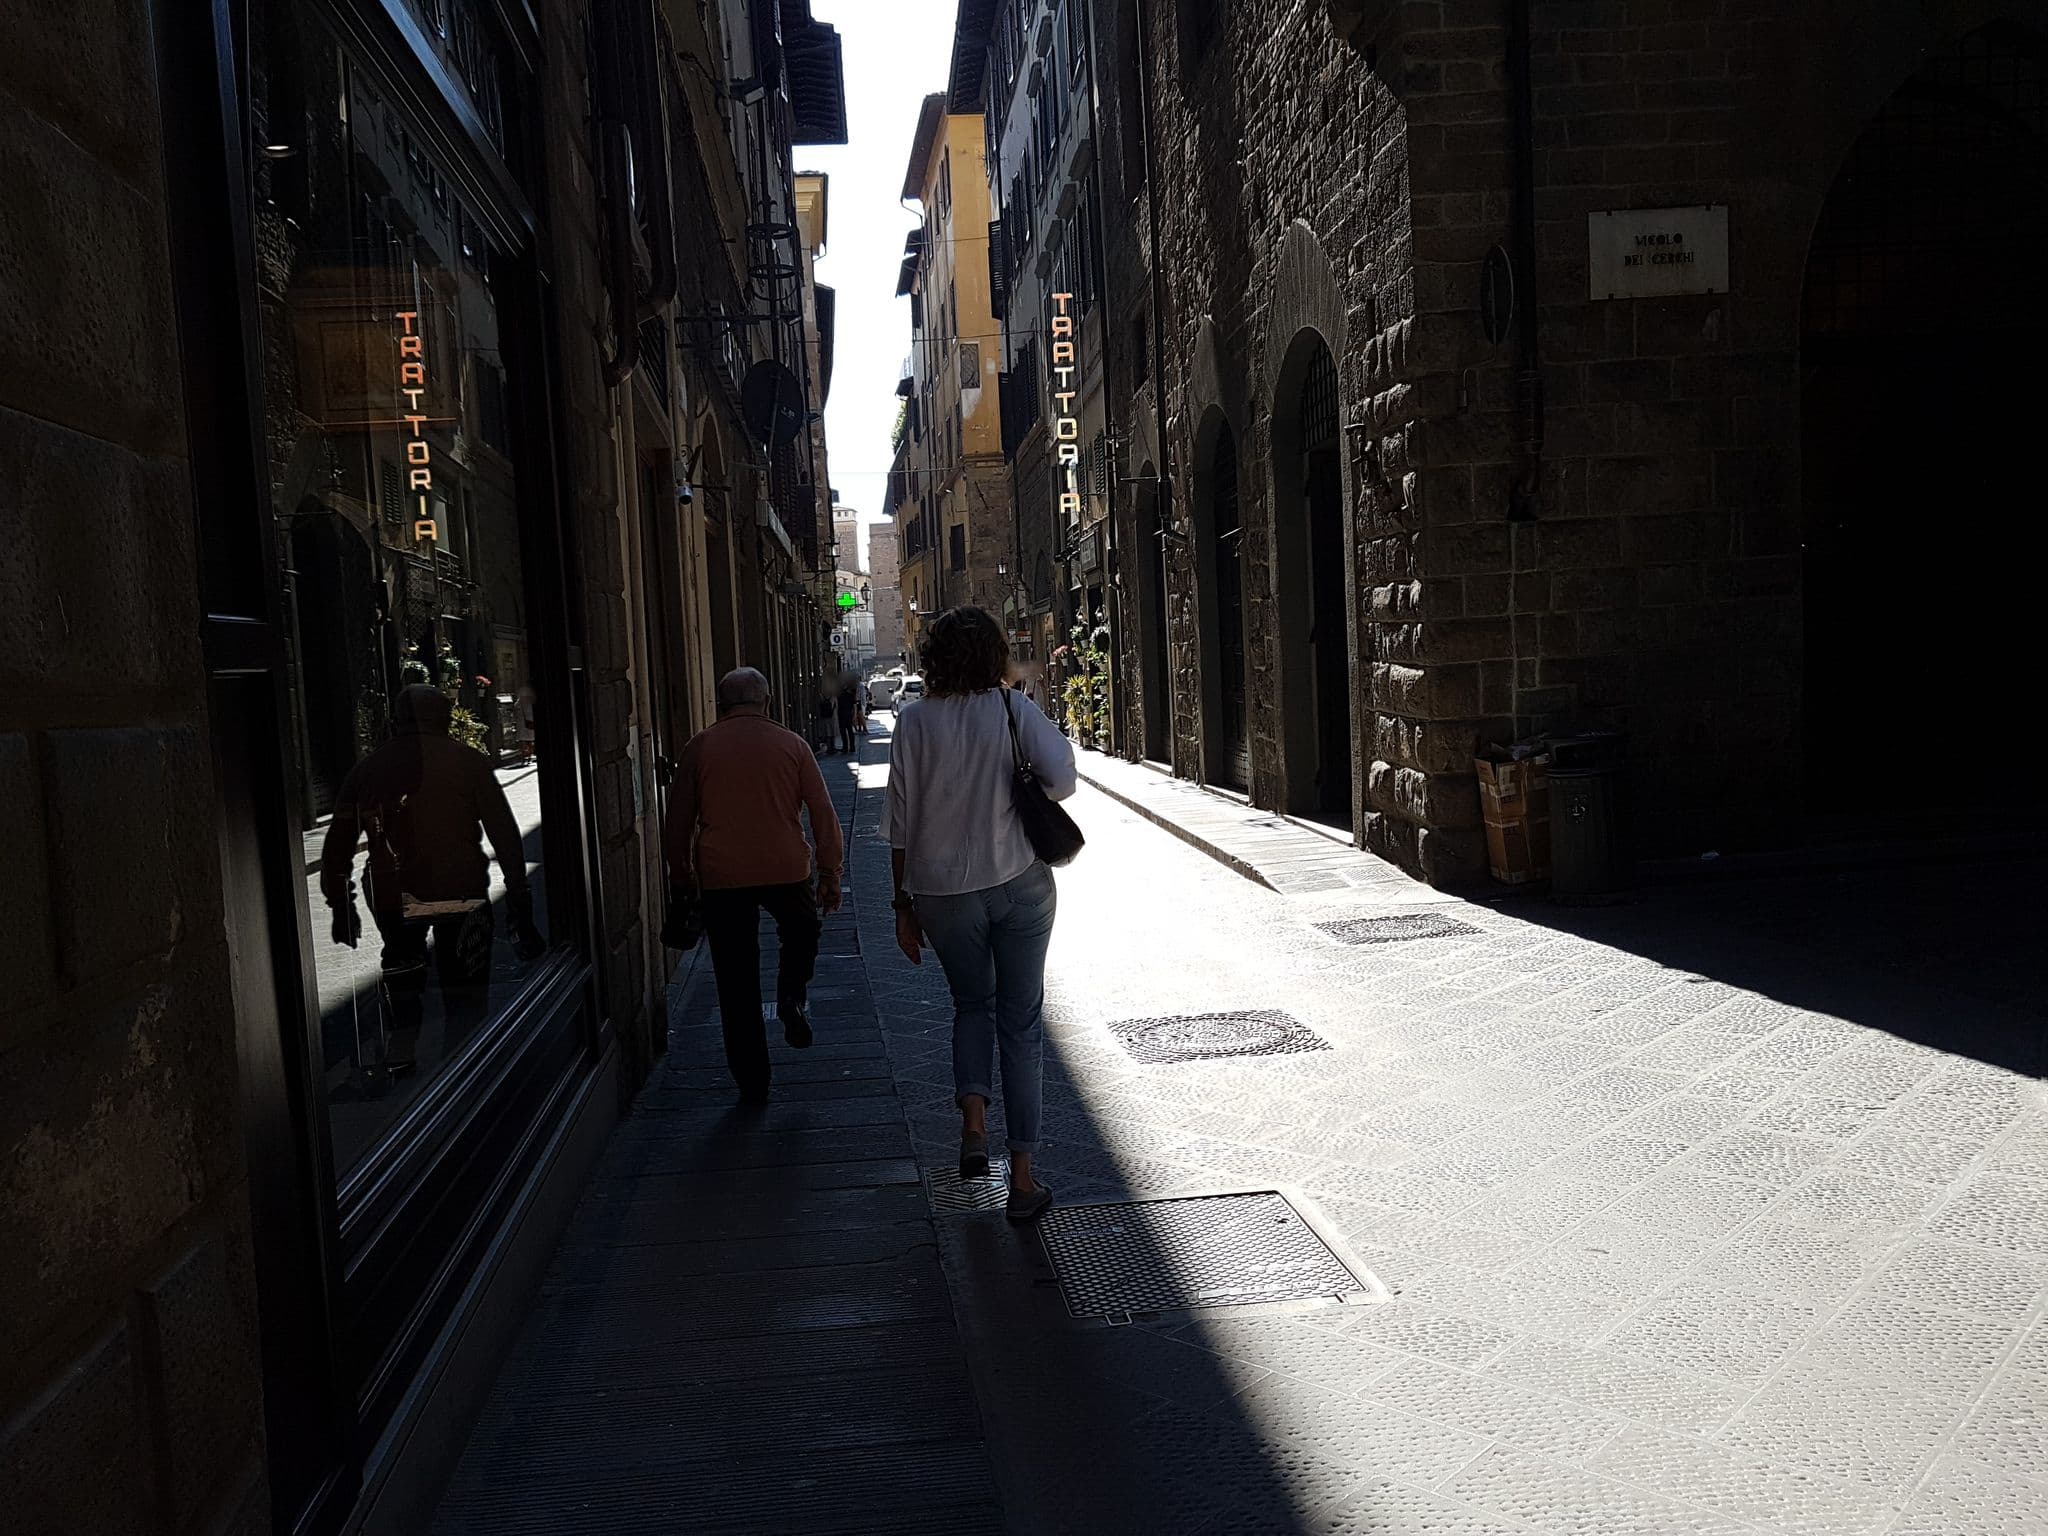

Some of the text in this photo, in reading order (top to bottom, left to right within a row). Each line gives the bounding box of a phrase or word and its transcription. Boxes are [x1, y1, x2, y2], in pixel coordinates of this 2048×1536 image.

[1635, 233, 1682, 247] VICOLO
[1625, 251, 1694, 266] DEI CERCHI
[396, 312, 437, 540] TRATTORIA
